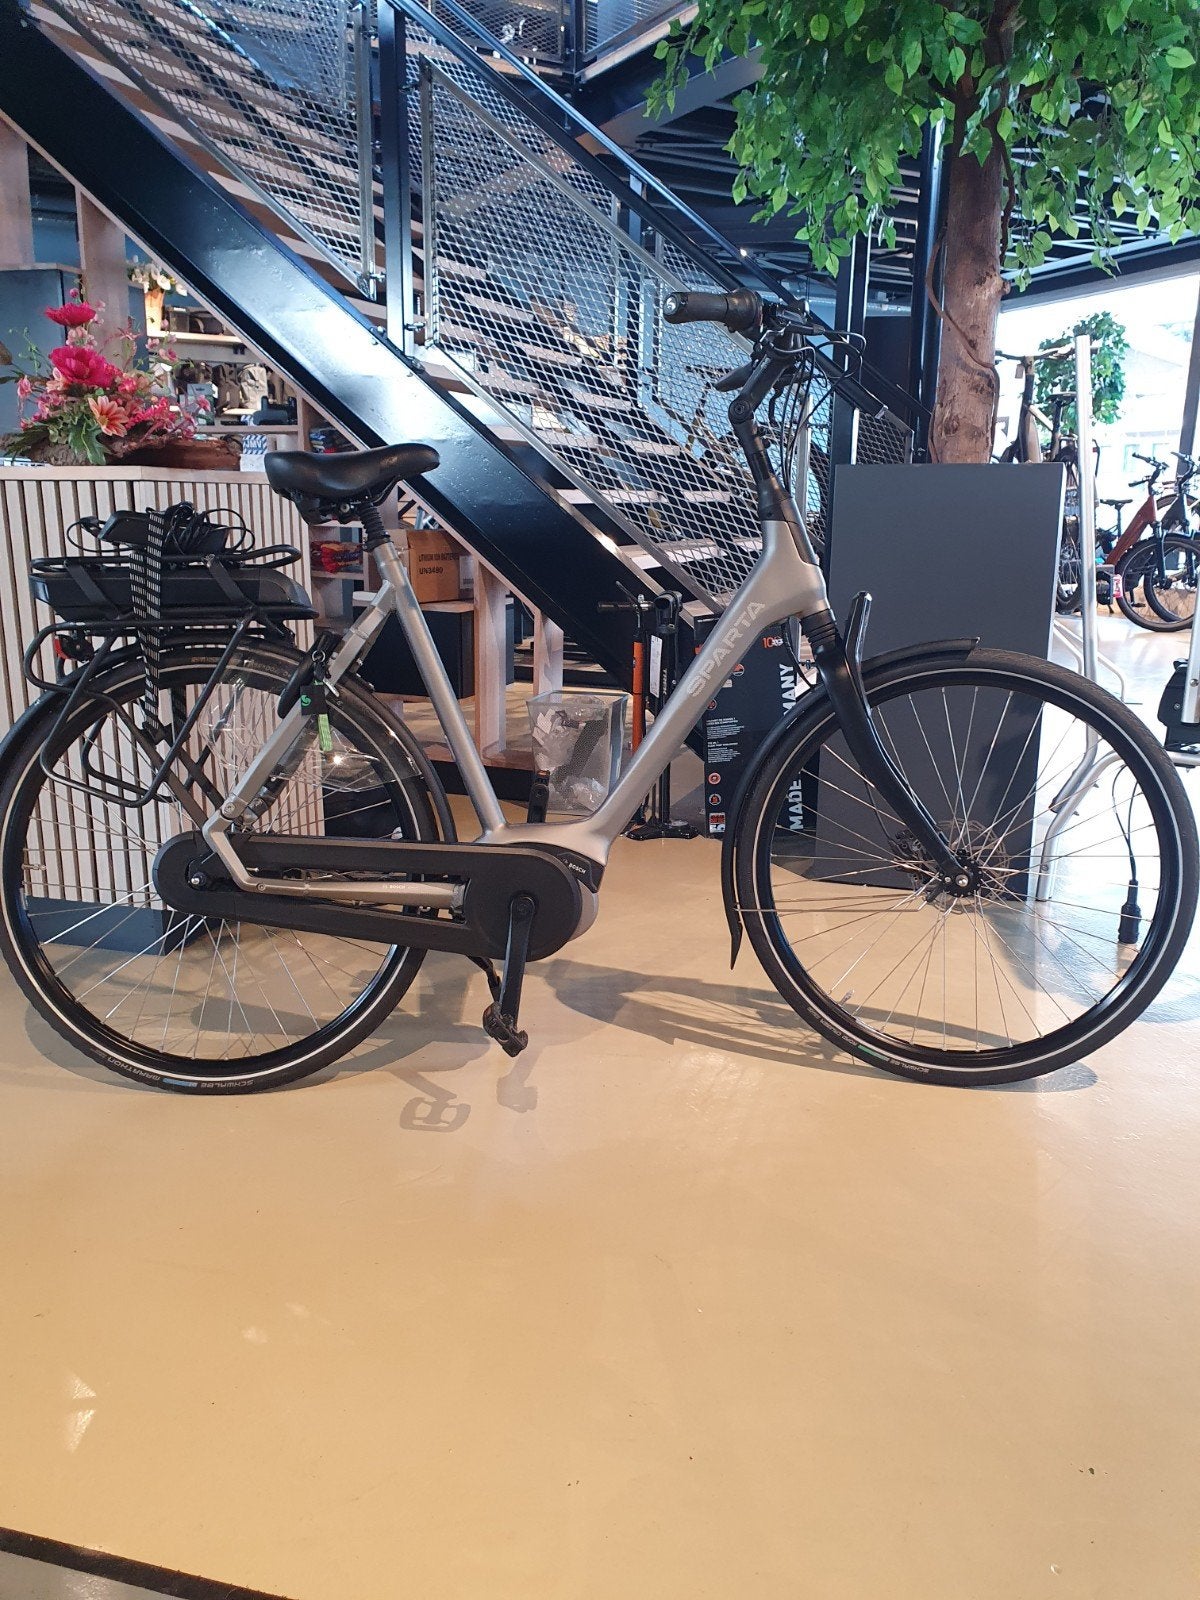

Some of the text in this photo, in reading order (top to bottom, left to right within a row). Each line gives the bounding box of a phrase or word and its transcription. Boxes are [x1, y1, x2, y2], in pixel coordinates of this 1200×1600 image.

[686, 599, 766, 698] SPARTA
[779, 663, 804, 831] MADE MANY
[568, 862, 587, 875] BOSCH
[107, 1056, 254, 1089] SCHWALBE MARATHON
[889, 1059, 930, 1074] SCHWALBE
